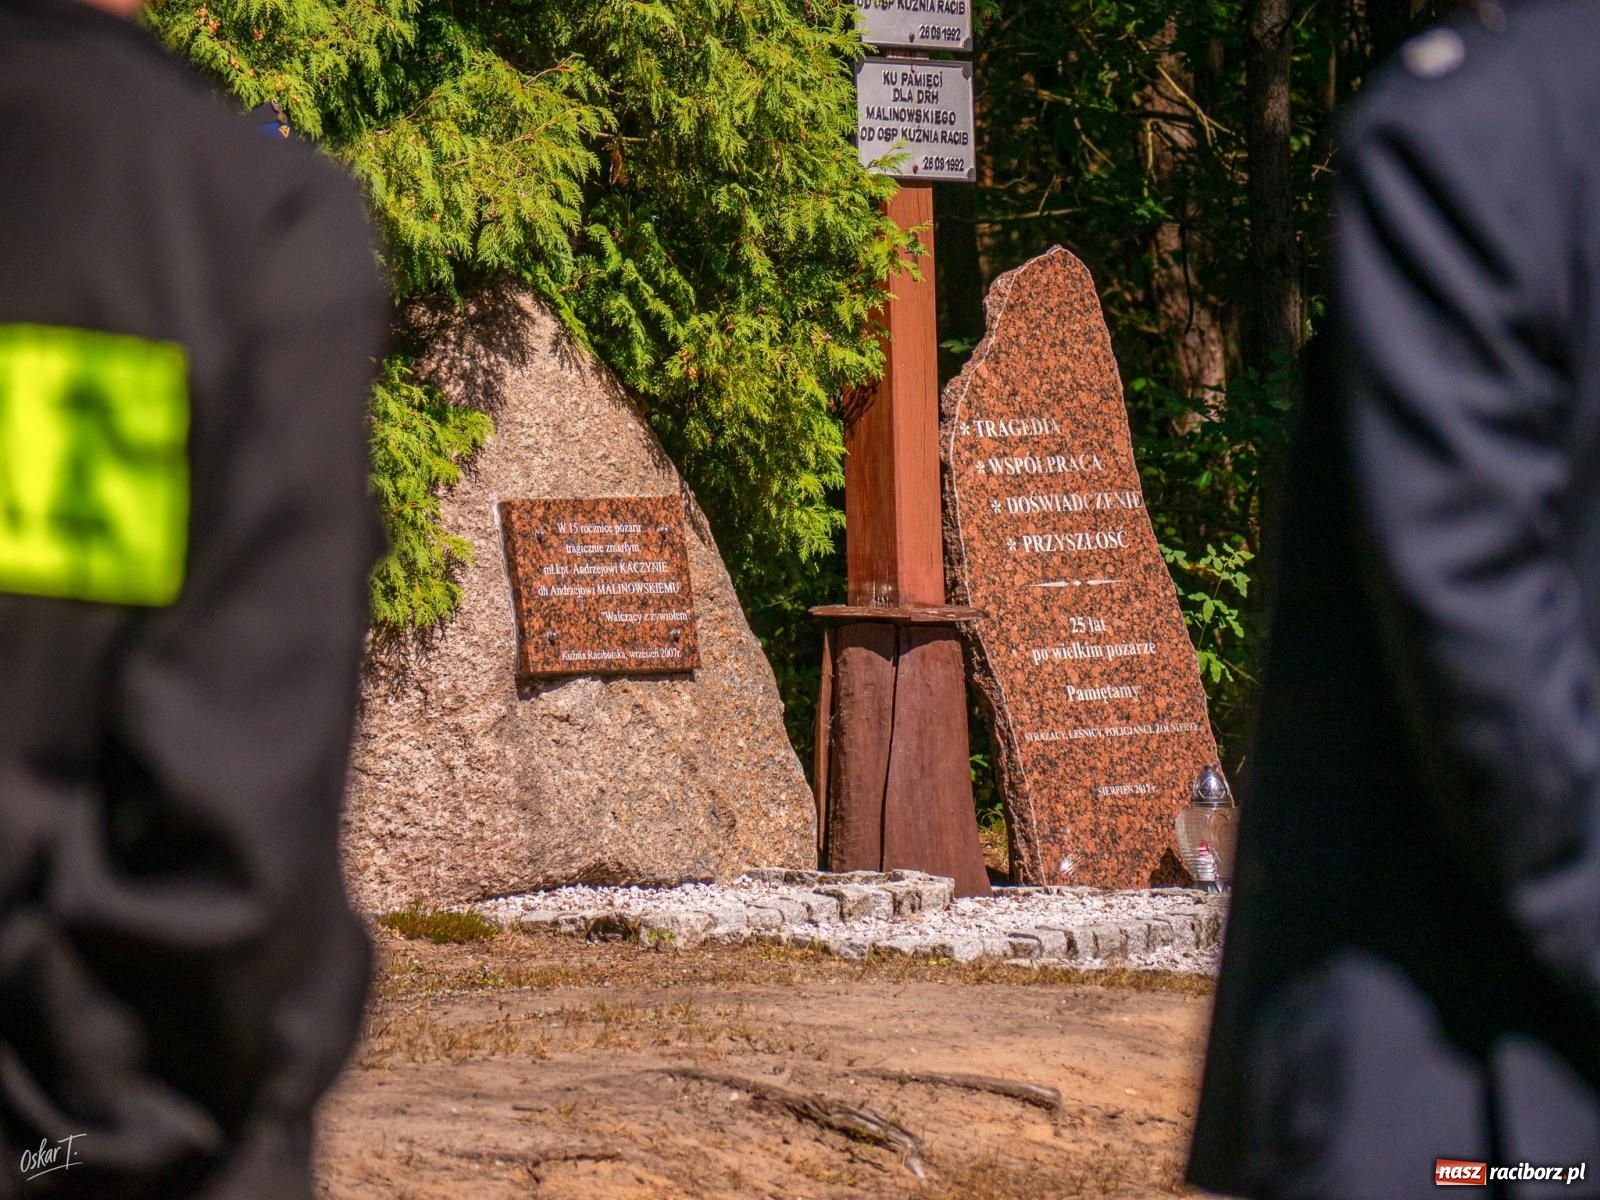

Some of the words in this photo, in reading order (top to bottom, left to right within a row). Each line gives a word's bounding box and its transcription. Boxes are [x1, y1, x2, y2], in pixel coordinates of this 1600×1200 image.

[937, 0, 966, 15] RACIB
[919, 25, 930, 40] 26
[942, 26, 961, 41] 1992
[883, 70, 898, 85] KU
[892, 88, 913, 102] DLA
[917, 89, 939, 104] DRH
[866, 106, 956, 125] MALINOWSKIEGO
[860, 127, 875, 141] OD
[877, 127, 898, 142] OSP
[901, 124, 939, 143] KUŹNIA
[941, 130, 969, 146] RACIB
[923, 156, 934, 170] 26
[945, 157, 965, 171] 1992
[974, 417, 1062, 438] TRAGEDIA
[1006, 491, 1143, 515] DOŚWIADCZENIE
[557, 522, 566, 534] W
[569, 522, 579, 534] 15
[580, 523, 613, 536] rocznicę
[614, 523, 642, 536] pożaru
[1022, 525, 1130, 553] PRZYSZŁOŚĆ
[565, 543, 604, 555] tragicznie
[573, 562, 618, 577] Andrzejowi
[620, 561, 669, 573] KACZYNIE
[538, 585, 550, 597] dh
[551, 585, 596, 598] Andrzejowi
[597, 582, 680, 595] MALINOWSKIEMU
[644, 612, 650, 621] z
[1069, 616, 1086, 634] 25
[1088, 616, 1106, 633] lat
[1031, 648, 1049, 666] po
[1052, 642, 1103, 661] wielkim
[1106, 640, 1157, 662] pożarze
[1066, 684, 1141, 704] Pamiętamy
